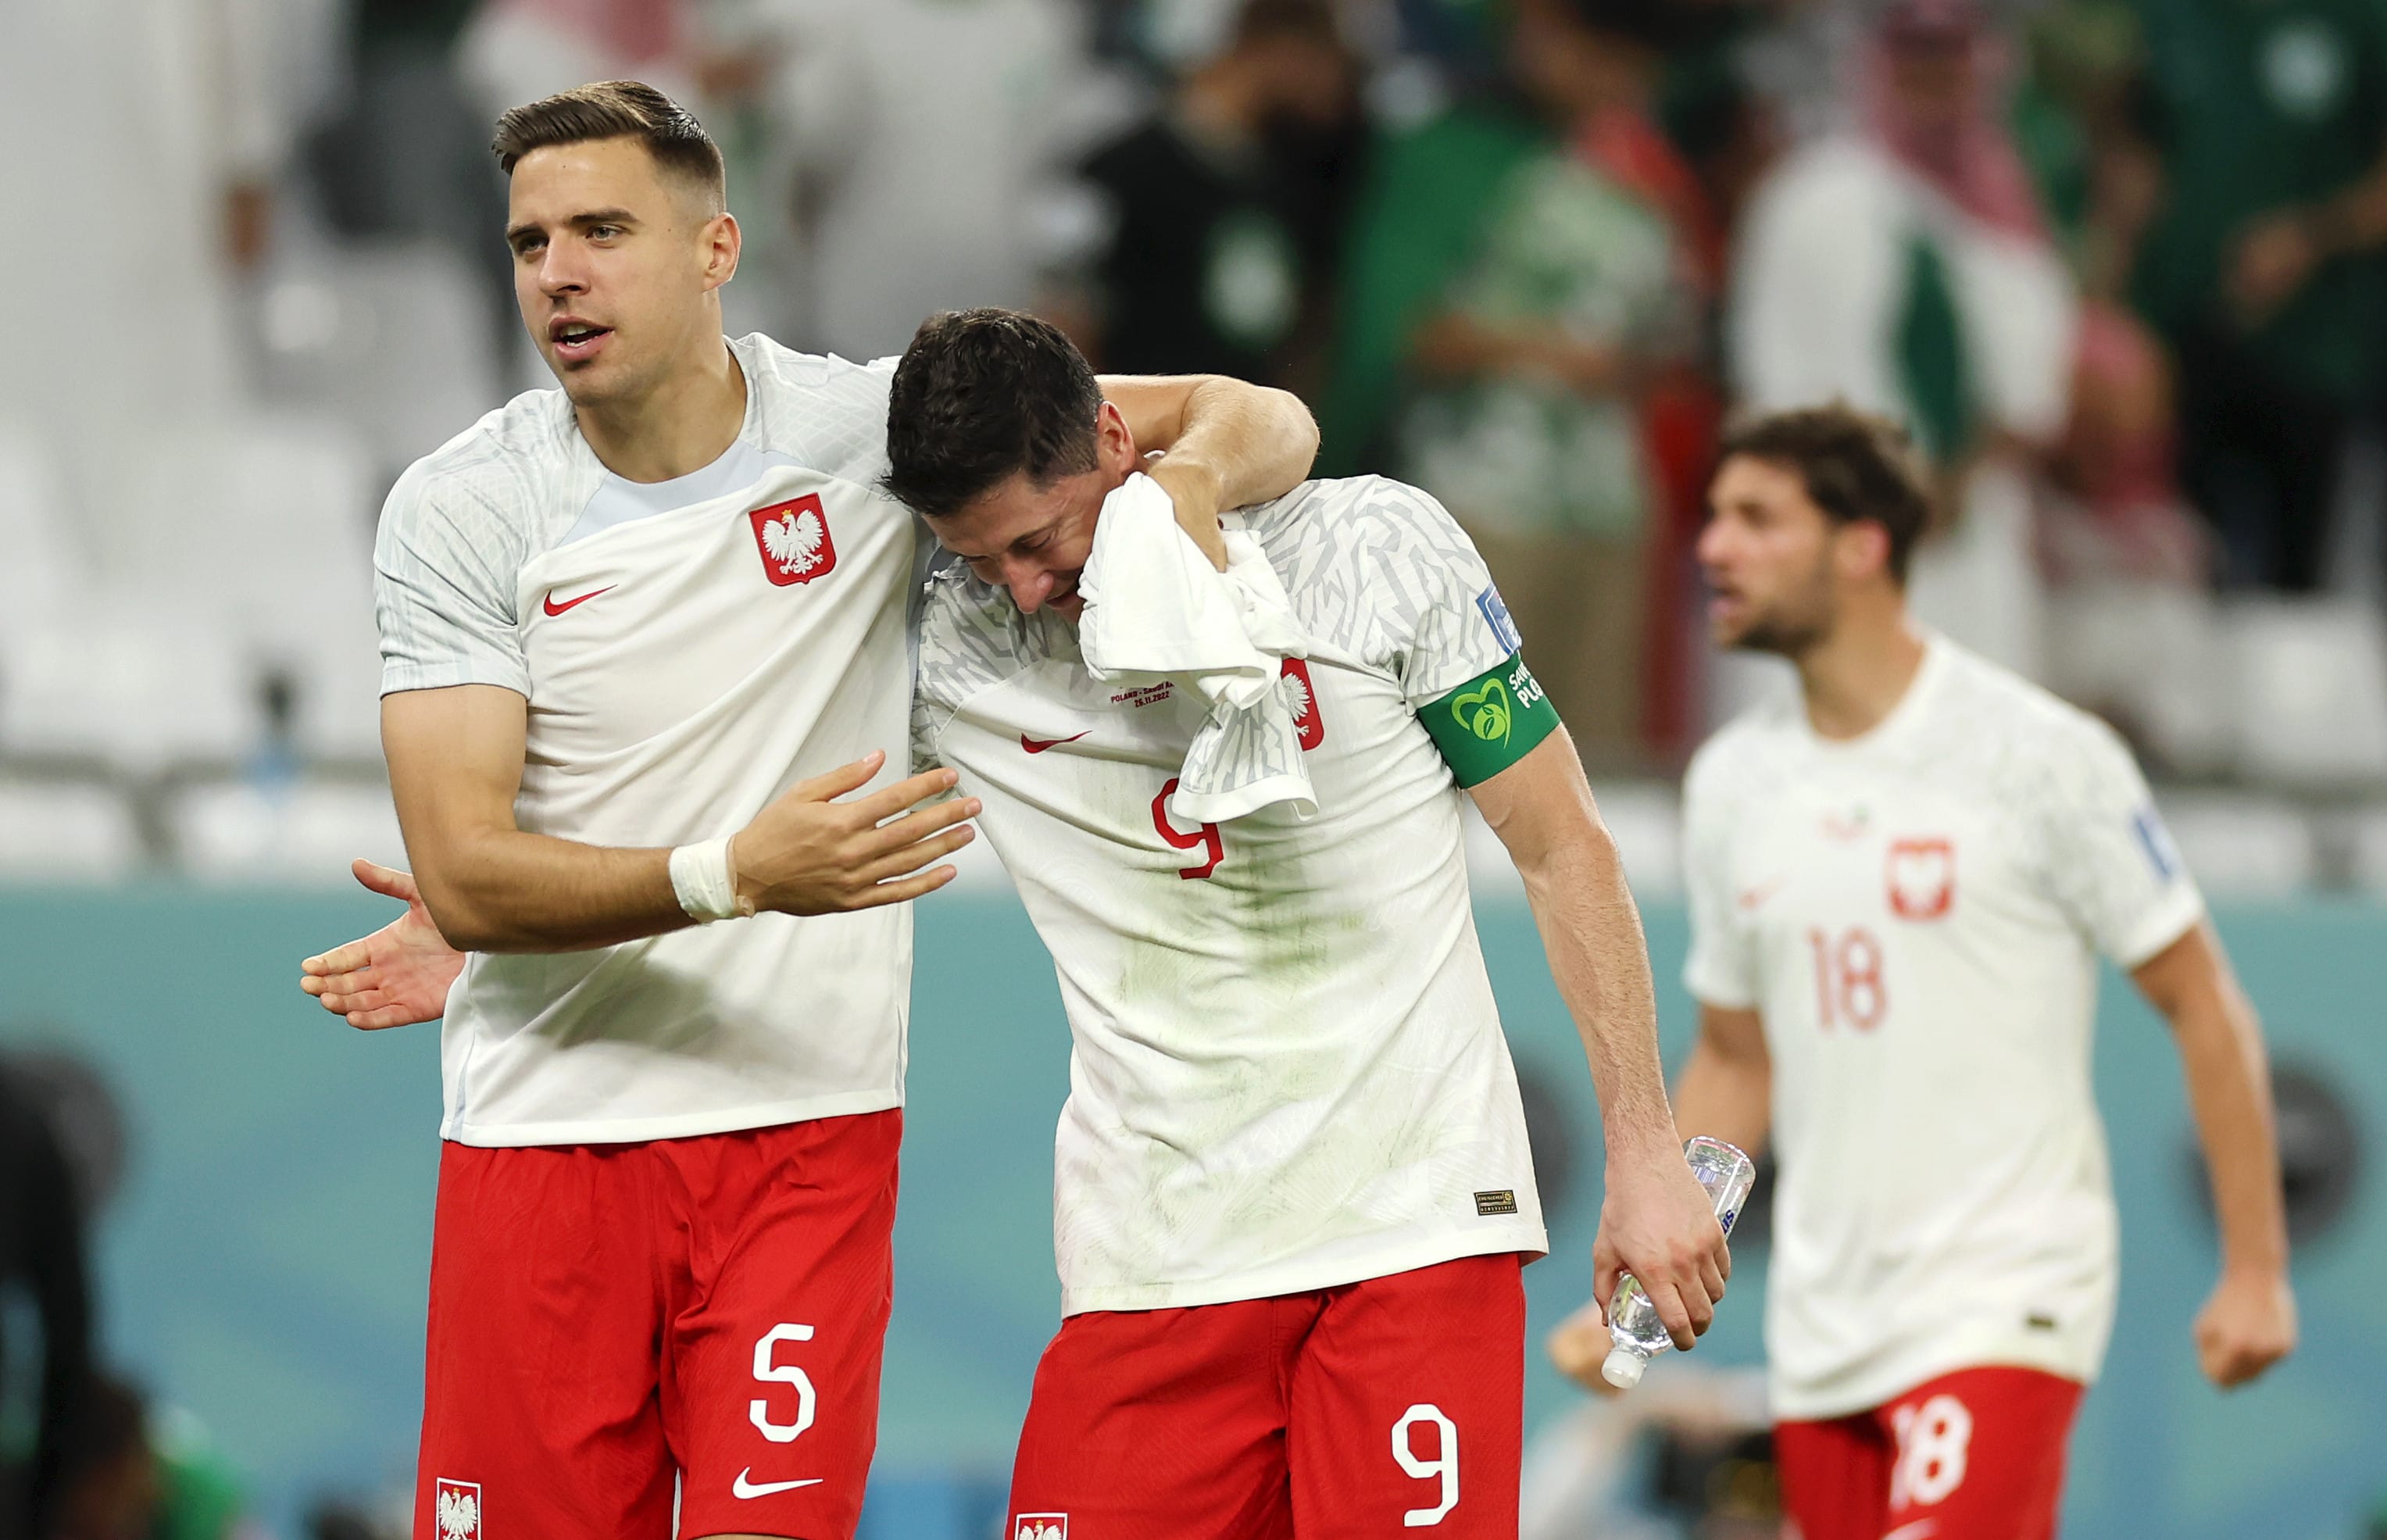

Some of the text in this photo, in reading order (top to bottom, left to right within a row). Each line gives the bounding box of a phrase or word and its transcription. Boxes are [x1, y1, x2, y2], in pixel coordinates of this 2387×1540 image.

[1110, 691, 1138, 703] POLAND
[1134, 691, 1170, 708] 26.11.2022
[1151, 777, 1224, 880] 9
[1806, 927, 1887, 1031] 18
[749, 1323, 816, 1442] 5
[1392, 1404, 1460, 1527] 9
[1890, 1394, 1973, 1513] 18
